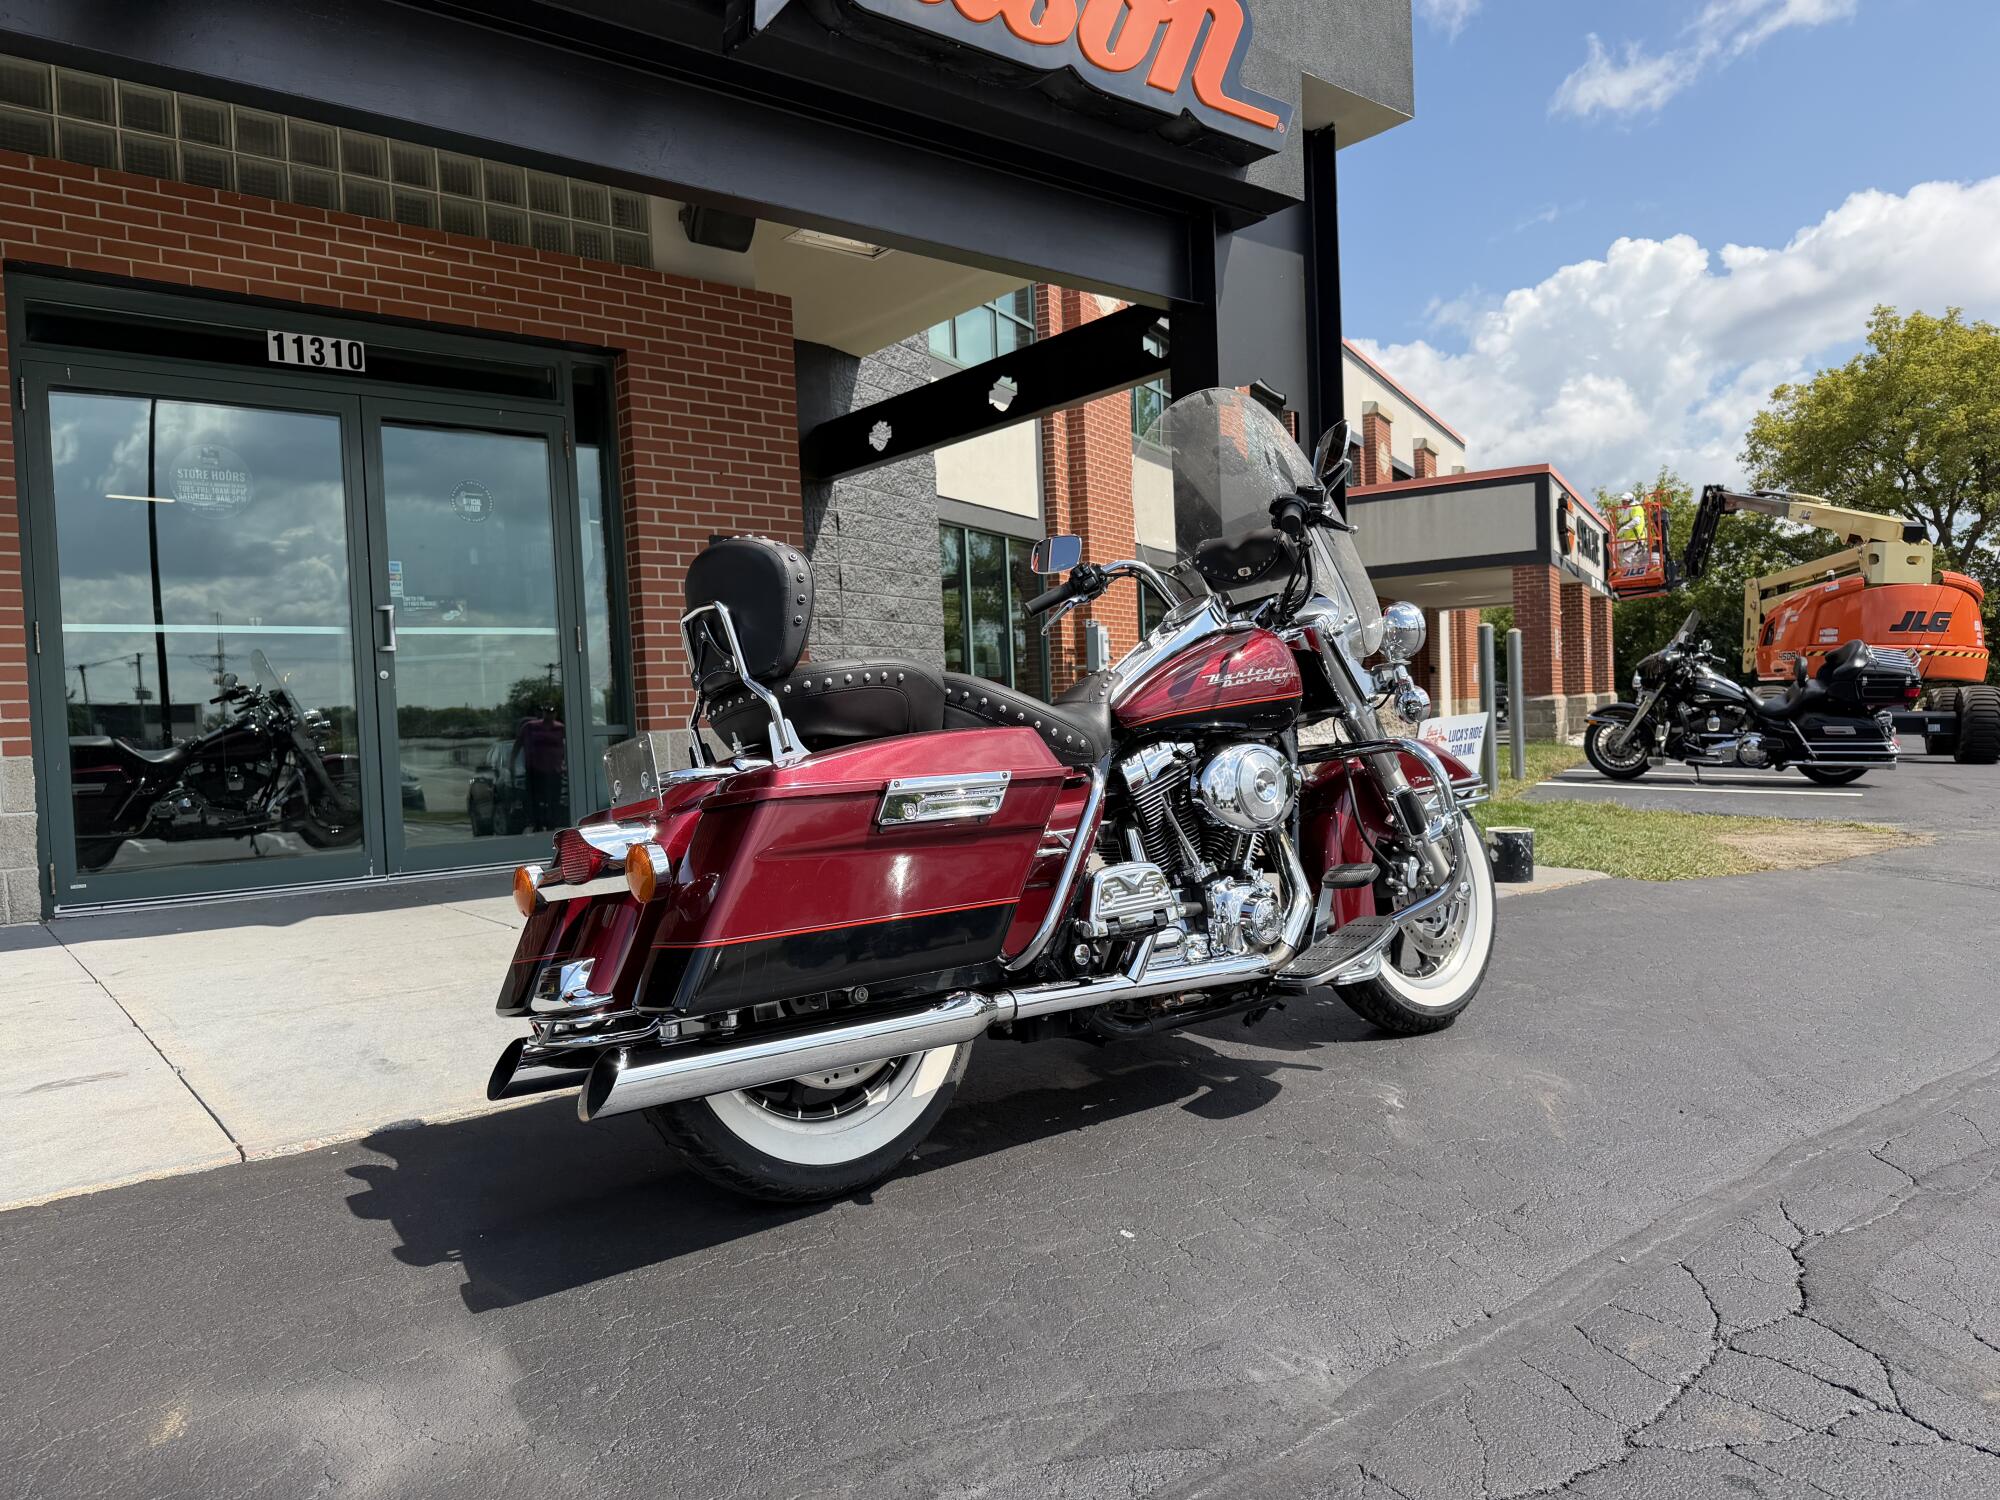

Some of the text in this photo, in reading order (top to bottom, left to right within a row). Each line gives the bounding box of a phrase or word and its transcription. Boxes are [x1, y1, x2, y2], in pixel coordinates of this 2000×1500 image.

[272, 333, 363, 370] 11310
[177, 467, 246, 482] STORE HOURS
[1623, 567, 1645, 577] JLG
[1888, 611, 1953, 633] JLG
[1202, 667, 1287, 685] Harley
[1222, 671, 1297, 688] Davidson
[1449, 727, 1469, 743] LUCA'S
[1469, 726, 1483, 741] RIDE
[1451, 742, 1475, 757] FOR AML
